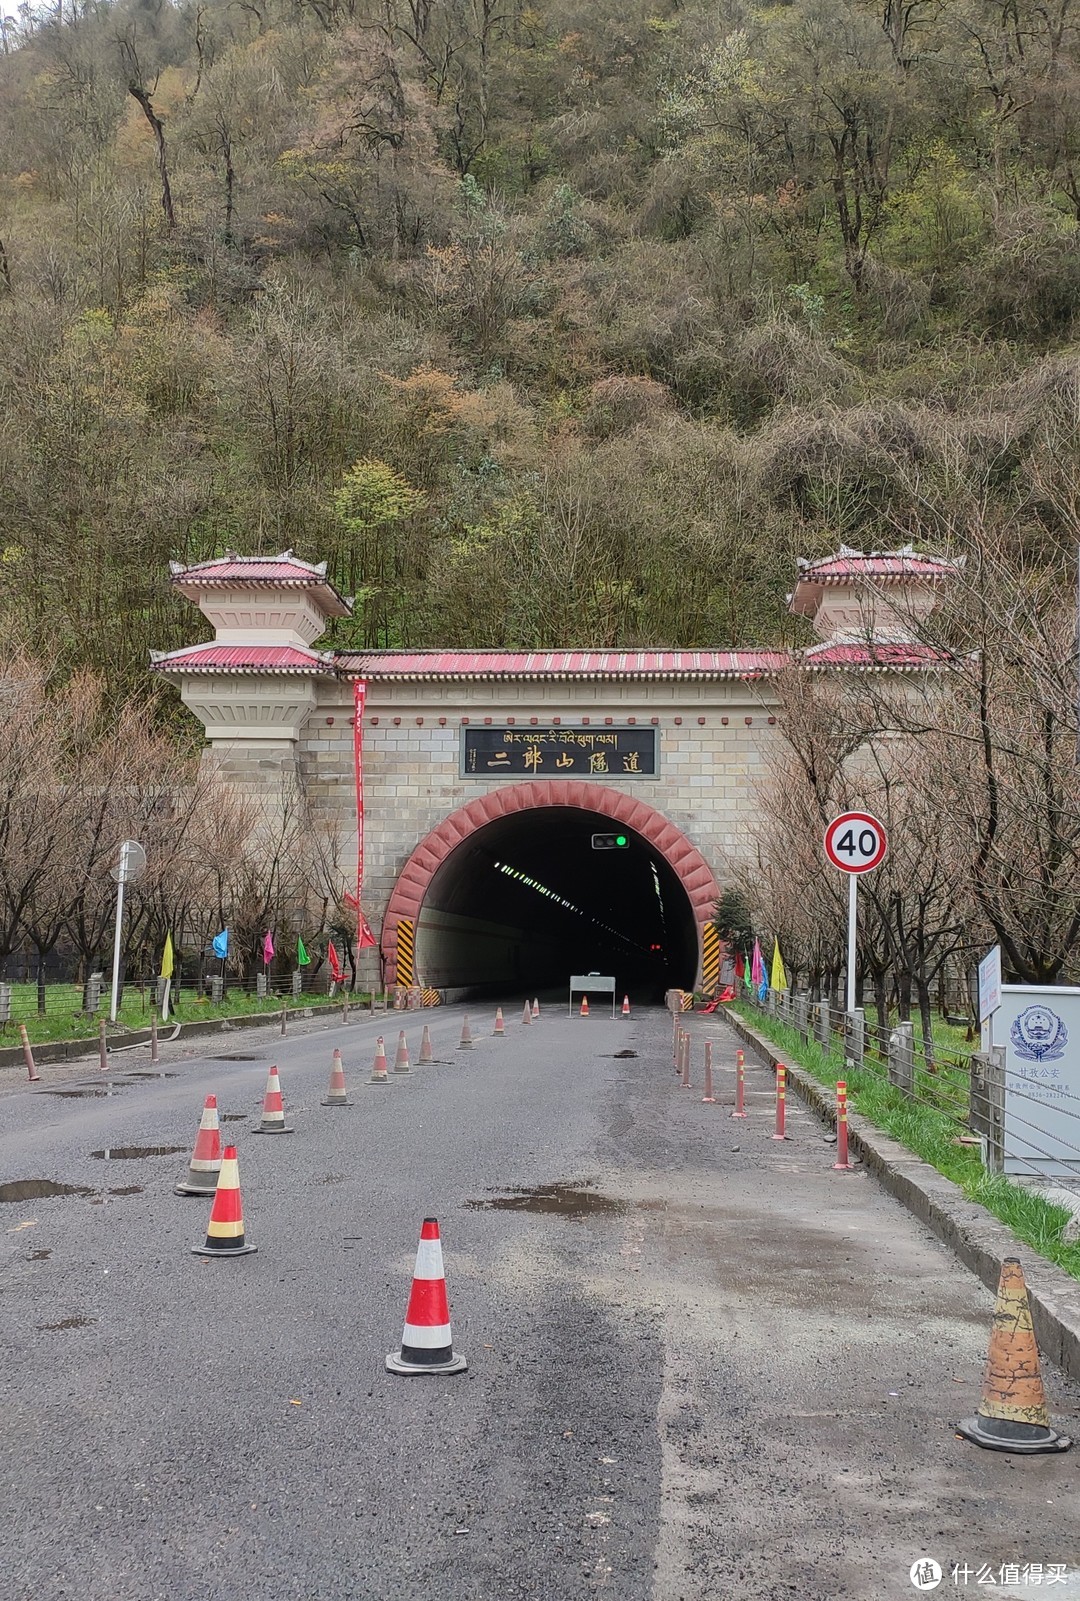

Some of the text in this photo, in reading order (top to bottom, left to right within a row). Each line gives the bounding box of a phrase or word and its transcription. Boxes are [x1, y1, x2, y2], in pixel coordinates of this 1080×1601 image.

[487, 745, 643, 774] 二郎山隧道
[836, 829, 877, 857] 40
[1020, 1067, 1060, 1079] 甘孜公安
